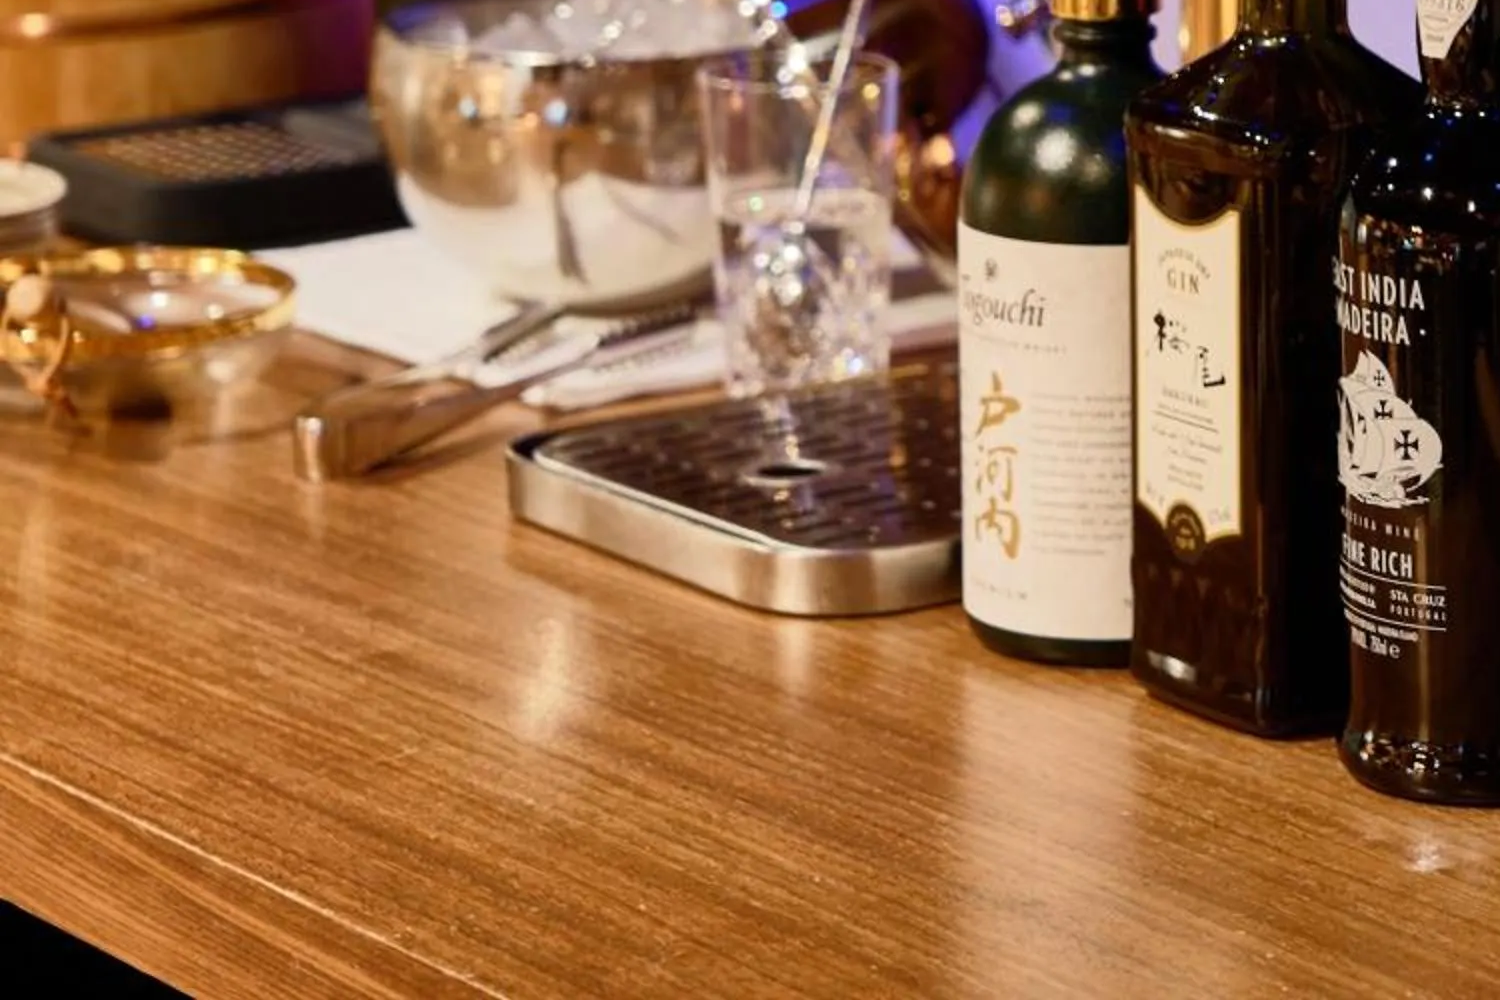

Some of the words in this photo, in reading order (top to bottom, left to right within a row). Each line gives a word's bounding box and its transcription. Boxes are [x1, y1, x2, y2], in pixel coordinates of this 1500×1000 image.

[1166, 267, 1200, 294] GIN
[1361, 268, 1425, 311] INDIA
[1371, 546, 1413, 579] RICH
